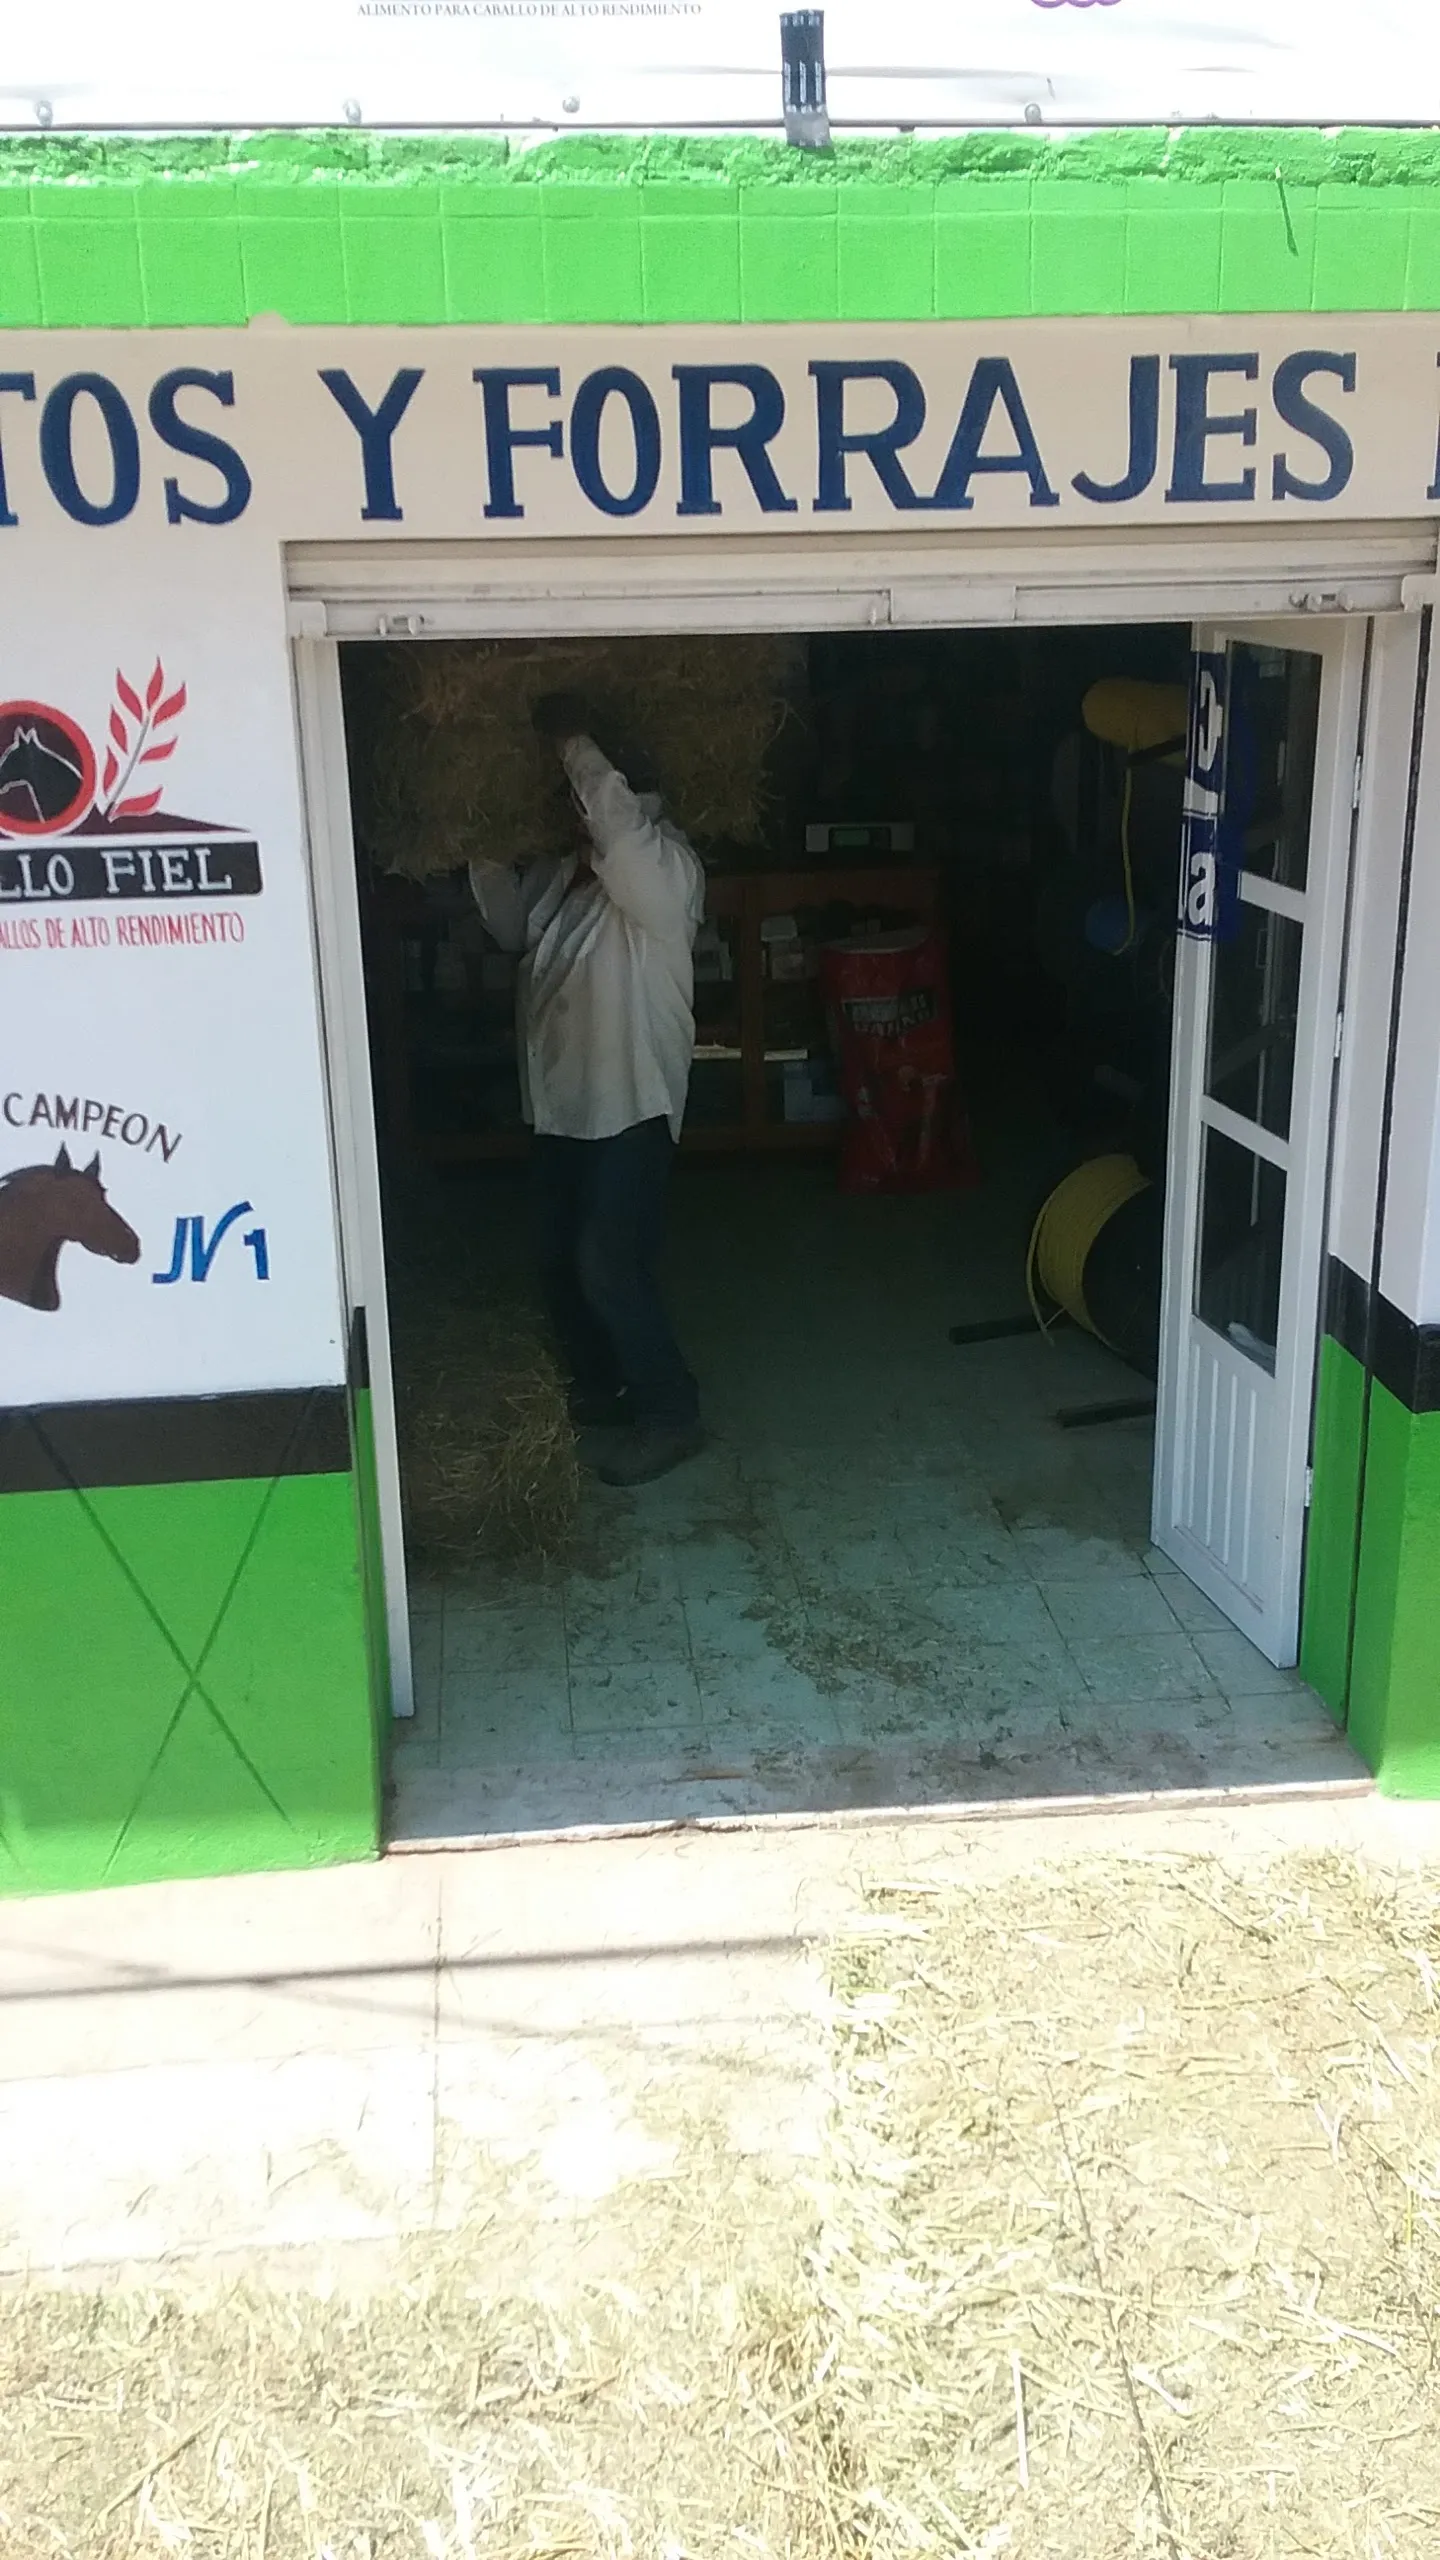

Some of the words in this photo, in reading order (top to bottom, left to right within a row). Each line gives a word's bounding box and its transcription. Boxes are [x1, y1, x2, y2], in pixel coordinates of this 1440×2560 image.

[357, 3, 432, 17] ALIMENTO
[434, 3, 471, 17] PARA
[473, 3, 538, 17] CABALLO
[540, 3, 557, 16] DE
[562, 3, 600, 16] ALTO
[602, 3, 702, 16] RENDIMIENTO
[317, 368, 426, 520] Y
[472, 350, 1357, 518] FORRAJES
[100, 847, 233, 893] FIEL
[45, 917, 66, 949] DE
[71, 915, 111, 948] ALTO
[116, 911, 245, 947] RENDIMIENTO
[3, 1092, 183, 1164] CAMPEON
